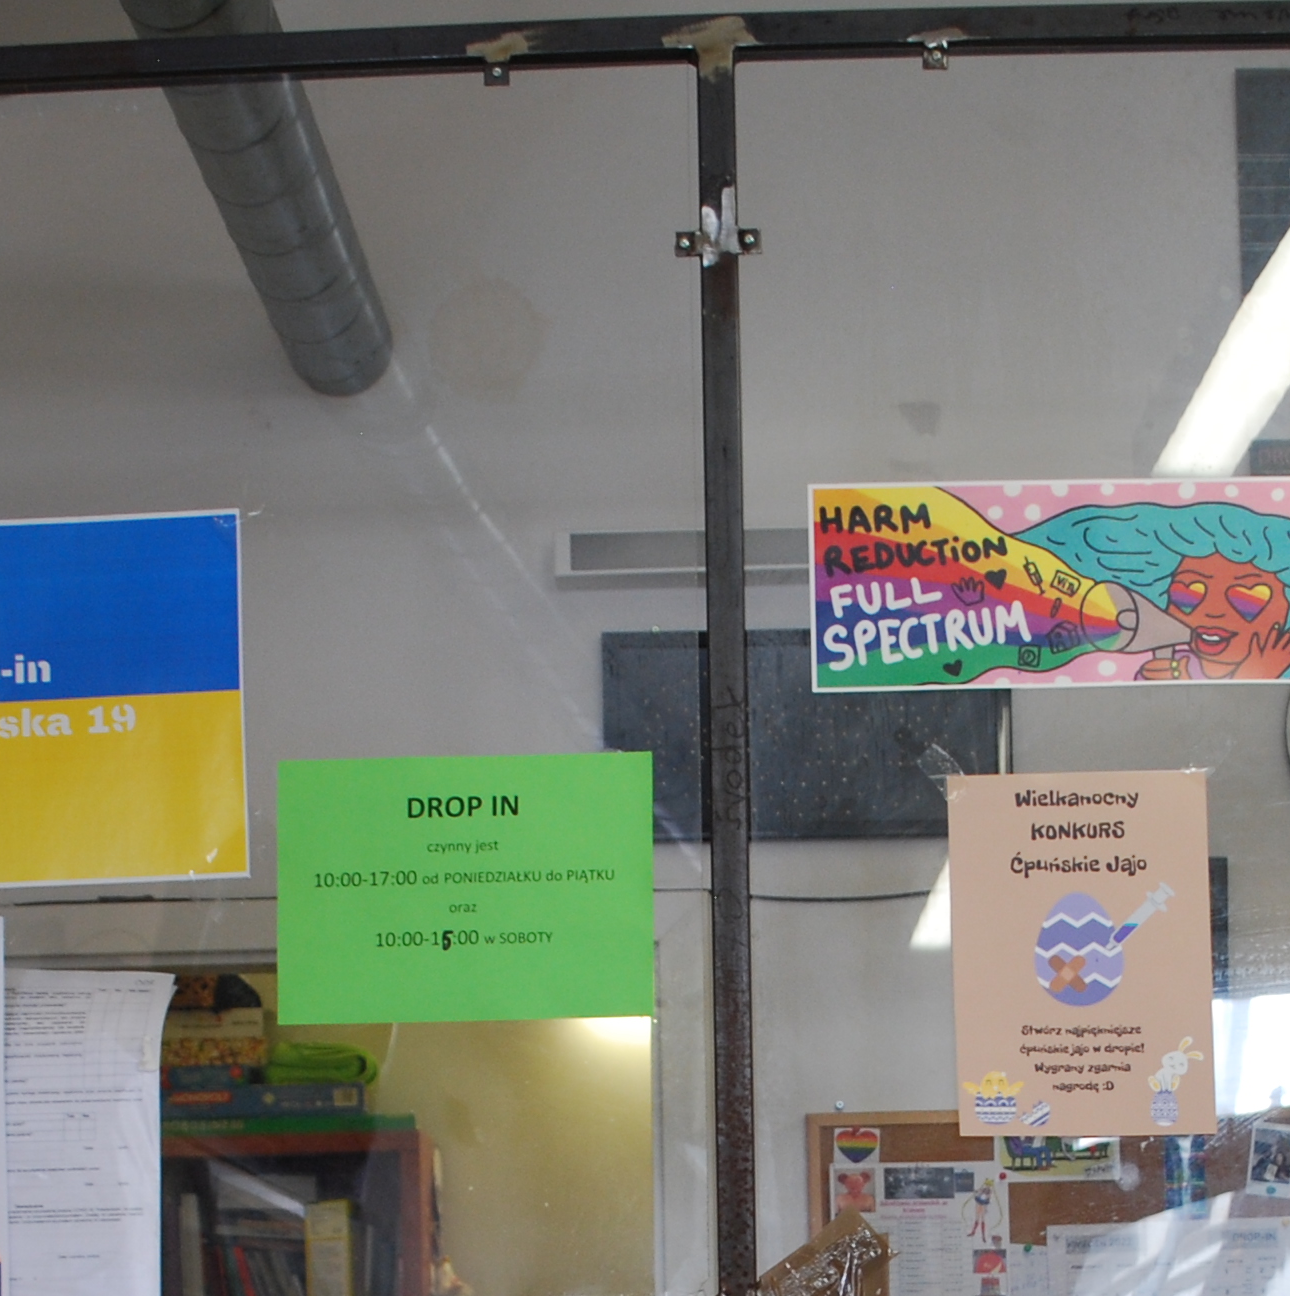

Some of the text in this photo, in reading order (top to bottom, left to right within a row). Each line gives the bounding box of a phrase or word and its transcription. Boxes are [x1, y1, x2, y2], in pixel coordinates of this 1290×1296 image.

[818, 503, 931, 534] HARM
[829, 577, 943, 619] FULL
[822, 600, 1032, 672] SPECTRUM
[87, 703, 137, 735] 19
[407, 795, 520, 819] DROP IN
[1014, 790, 1139, 808] Wielkanocny
[1030, 821, 1126, 842] KONKURS
[426, 839, 499, 854] czynny jest
[1009, 851, 1147, 878] Ćpuńskie Jajo
[313, 868, 615, 888] 10:00-17:00 od PONIEDZIAŁKU do PIĄTKU
[448, 903, 477, 914] oraz
[484, 934, 495, 945] w
[499, 930, 553, 945] SOBOTY
[1020, 1025, 1062, 1036] Stwórz
[1070, 1043, 1090, 1057] jajo
[1092, 1045, 1101, 1053] w
[1104, 1043, 1145, 1056] dropie!
[1034, 1061, 1131, 1074] Wygrany zgarnia
[1052, 1080, 1115, 1093] nagrodę :D
